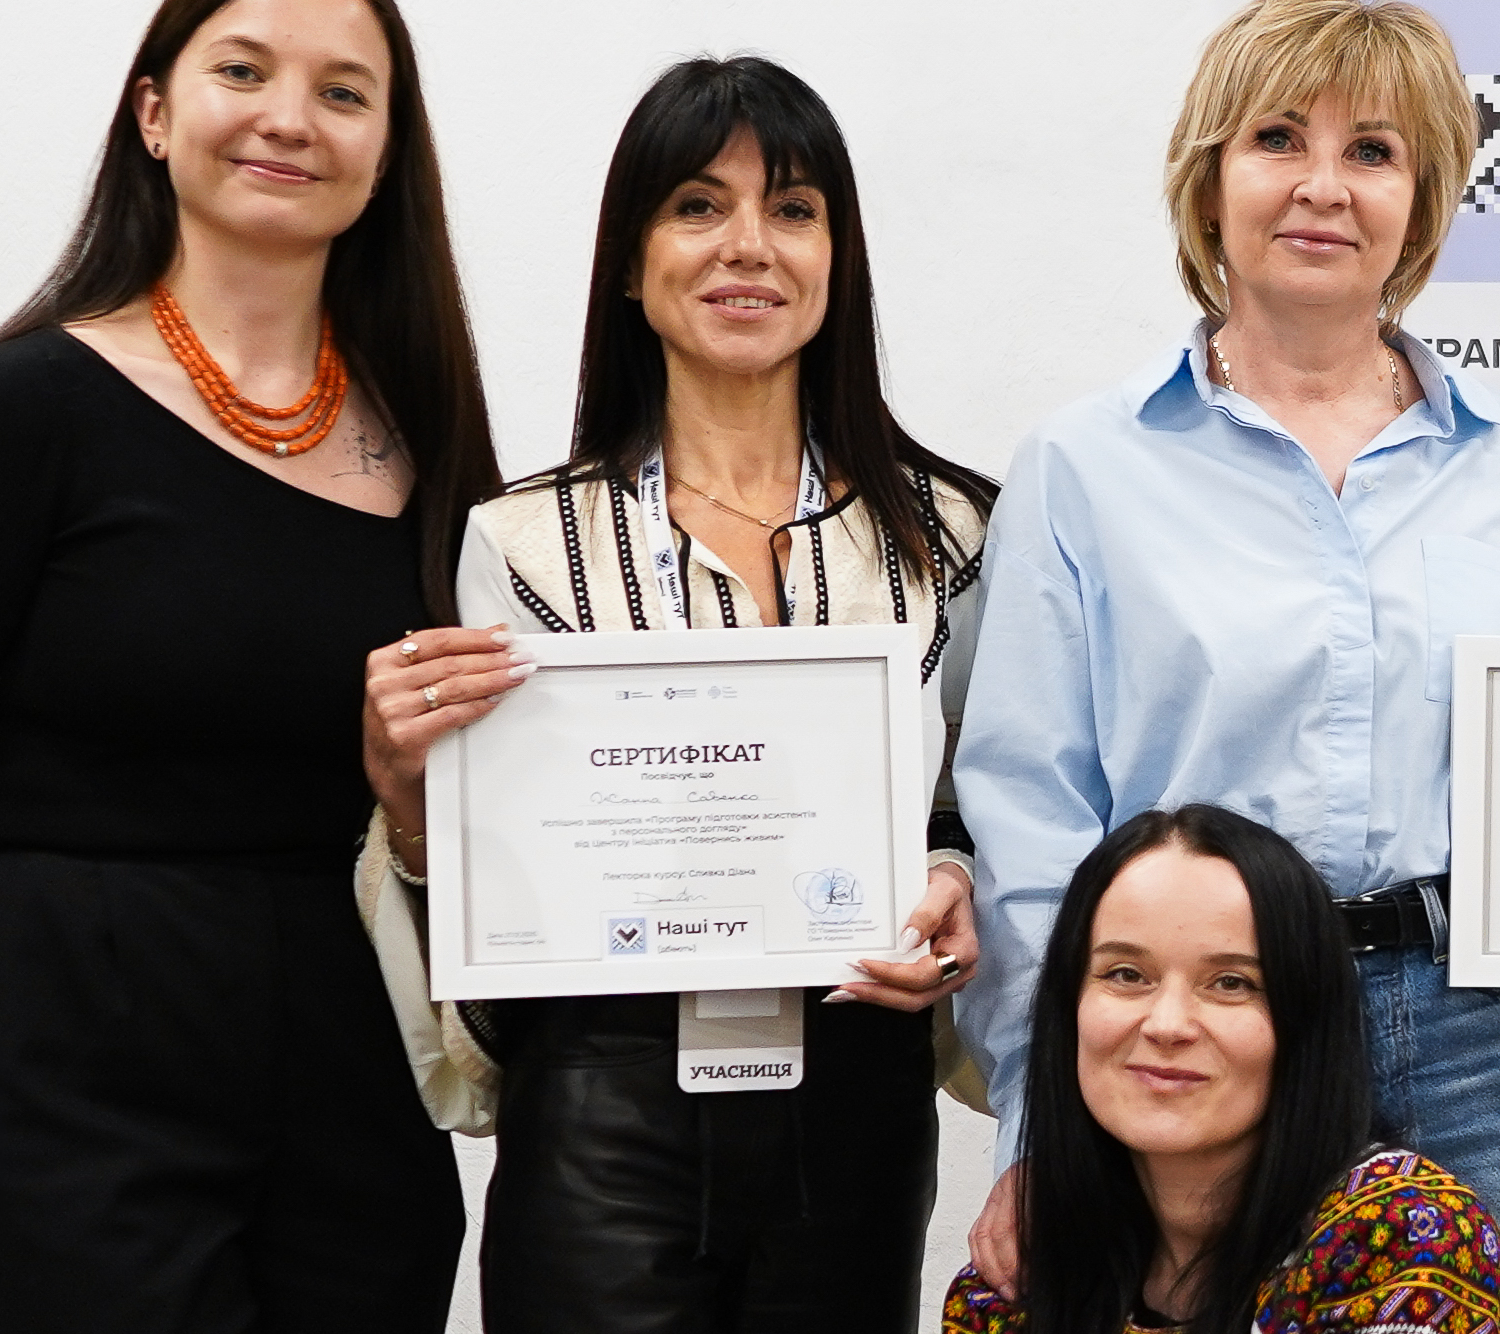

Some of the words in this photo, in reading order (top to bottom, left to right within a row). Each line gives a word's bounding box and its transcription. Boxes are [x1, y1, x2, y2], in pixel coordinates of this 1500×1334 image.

[589, 743, 766, 767] СЕРТИФІКАТ
[657, 918, 708, 936] Наші
[713, 921, 749, 939] тут
[689, 1063, 793, 1080] УЧАСНИЦЯ
